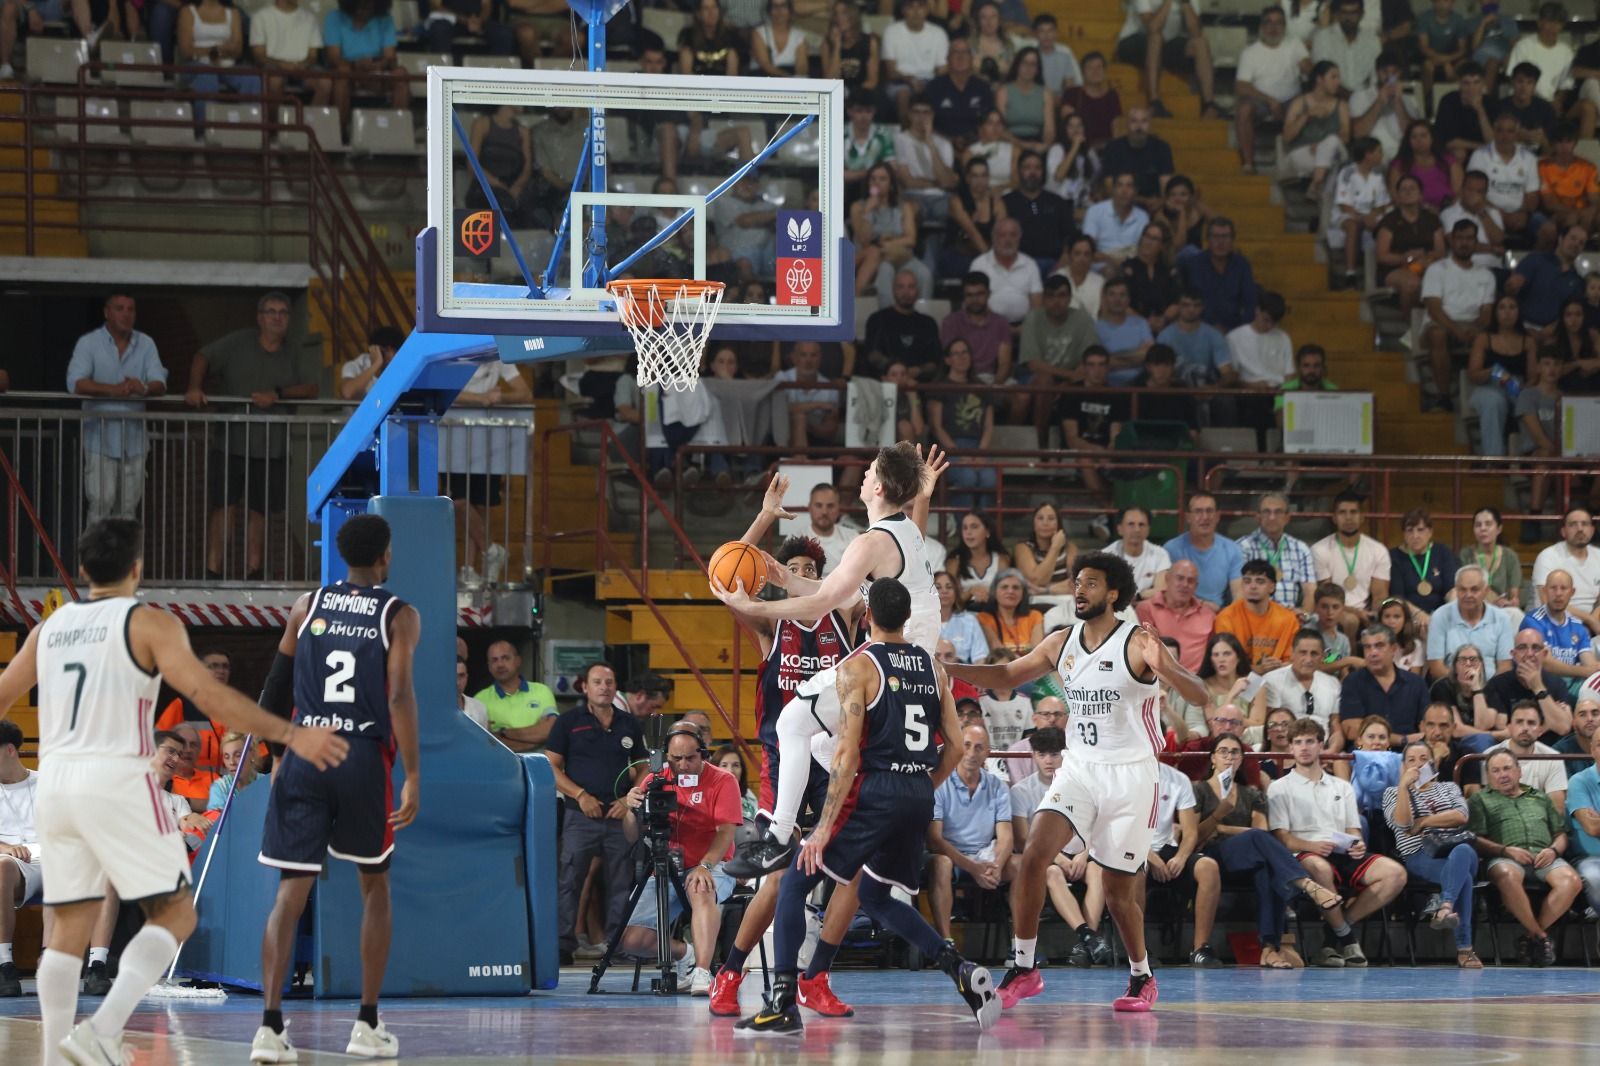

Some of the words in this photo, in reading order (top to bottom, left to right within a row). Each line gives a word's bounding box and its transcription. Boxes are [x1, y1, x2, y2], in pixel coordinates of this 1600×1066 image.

[523, 337, 545, 351] MONDO
[321, 592, 378, 616] SIMMONS
[327, 624, 378, 639] AMUTIO
[780, 652, 839, 670] kosner
[323, 650, 356, 703] 2
[63, 662, 87, 732] 7
[1064, 686, 1121, 702] Emirates
[1081, 702, 1112, 716] BETTER
[904, 704, 929, 751] 5
[468, 964, 522, 977] MONDO
